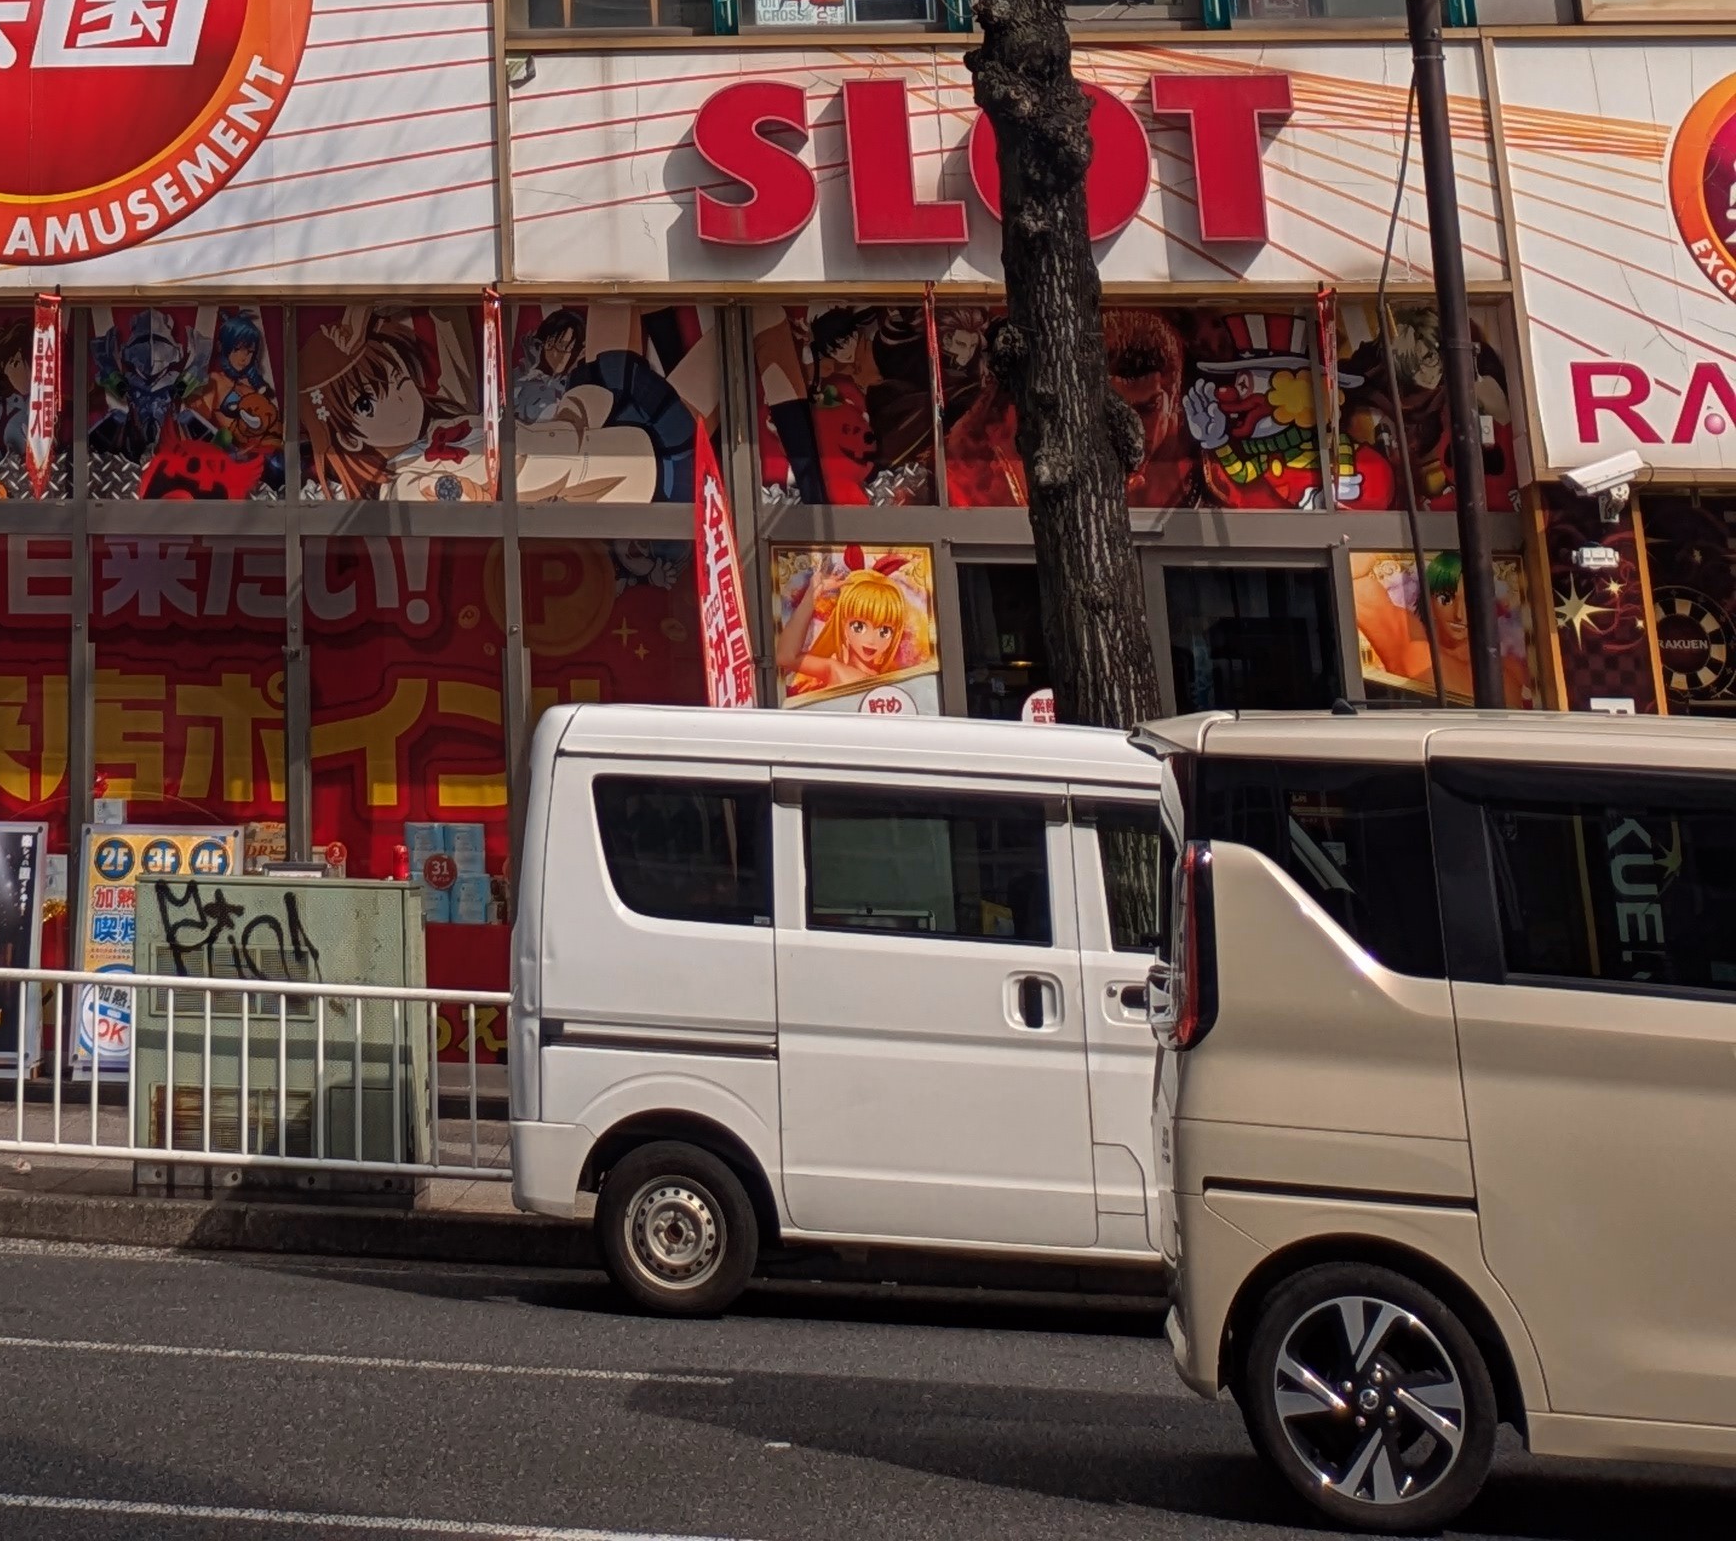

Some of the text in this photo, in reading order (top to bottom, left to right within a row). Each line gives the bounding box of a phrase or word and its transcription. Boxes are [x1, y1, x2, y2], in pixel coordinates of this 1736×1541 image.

[3, 53, 287, 257] AMUSEMENT
[1658, 638, 1709, 652] RAKUEN
[868, 695, 902, 715] 貯め
[101, 846, 225, 873] 2F 3F 4F
[431, 861, 449, 876] 31
